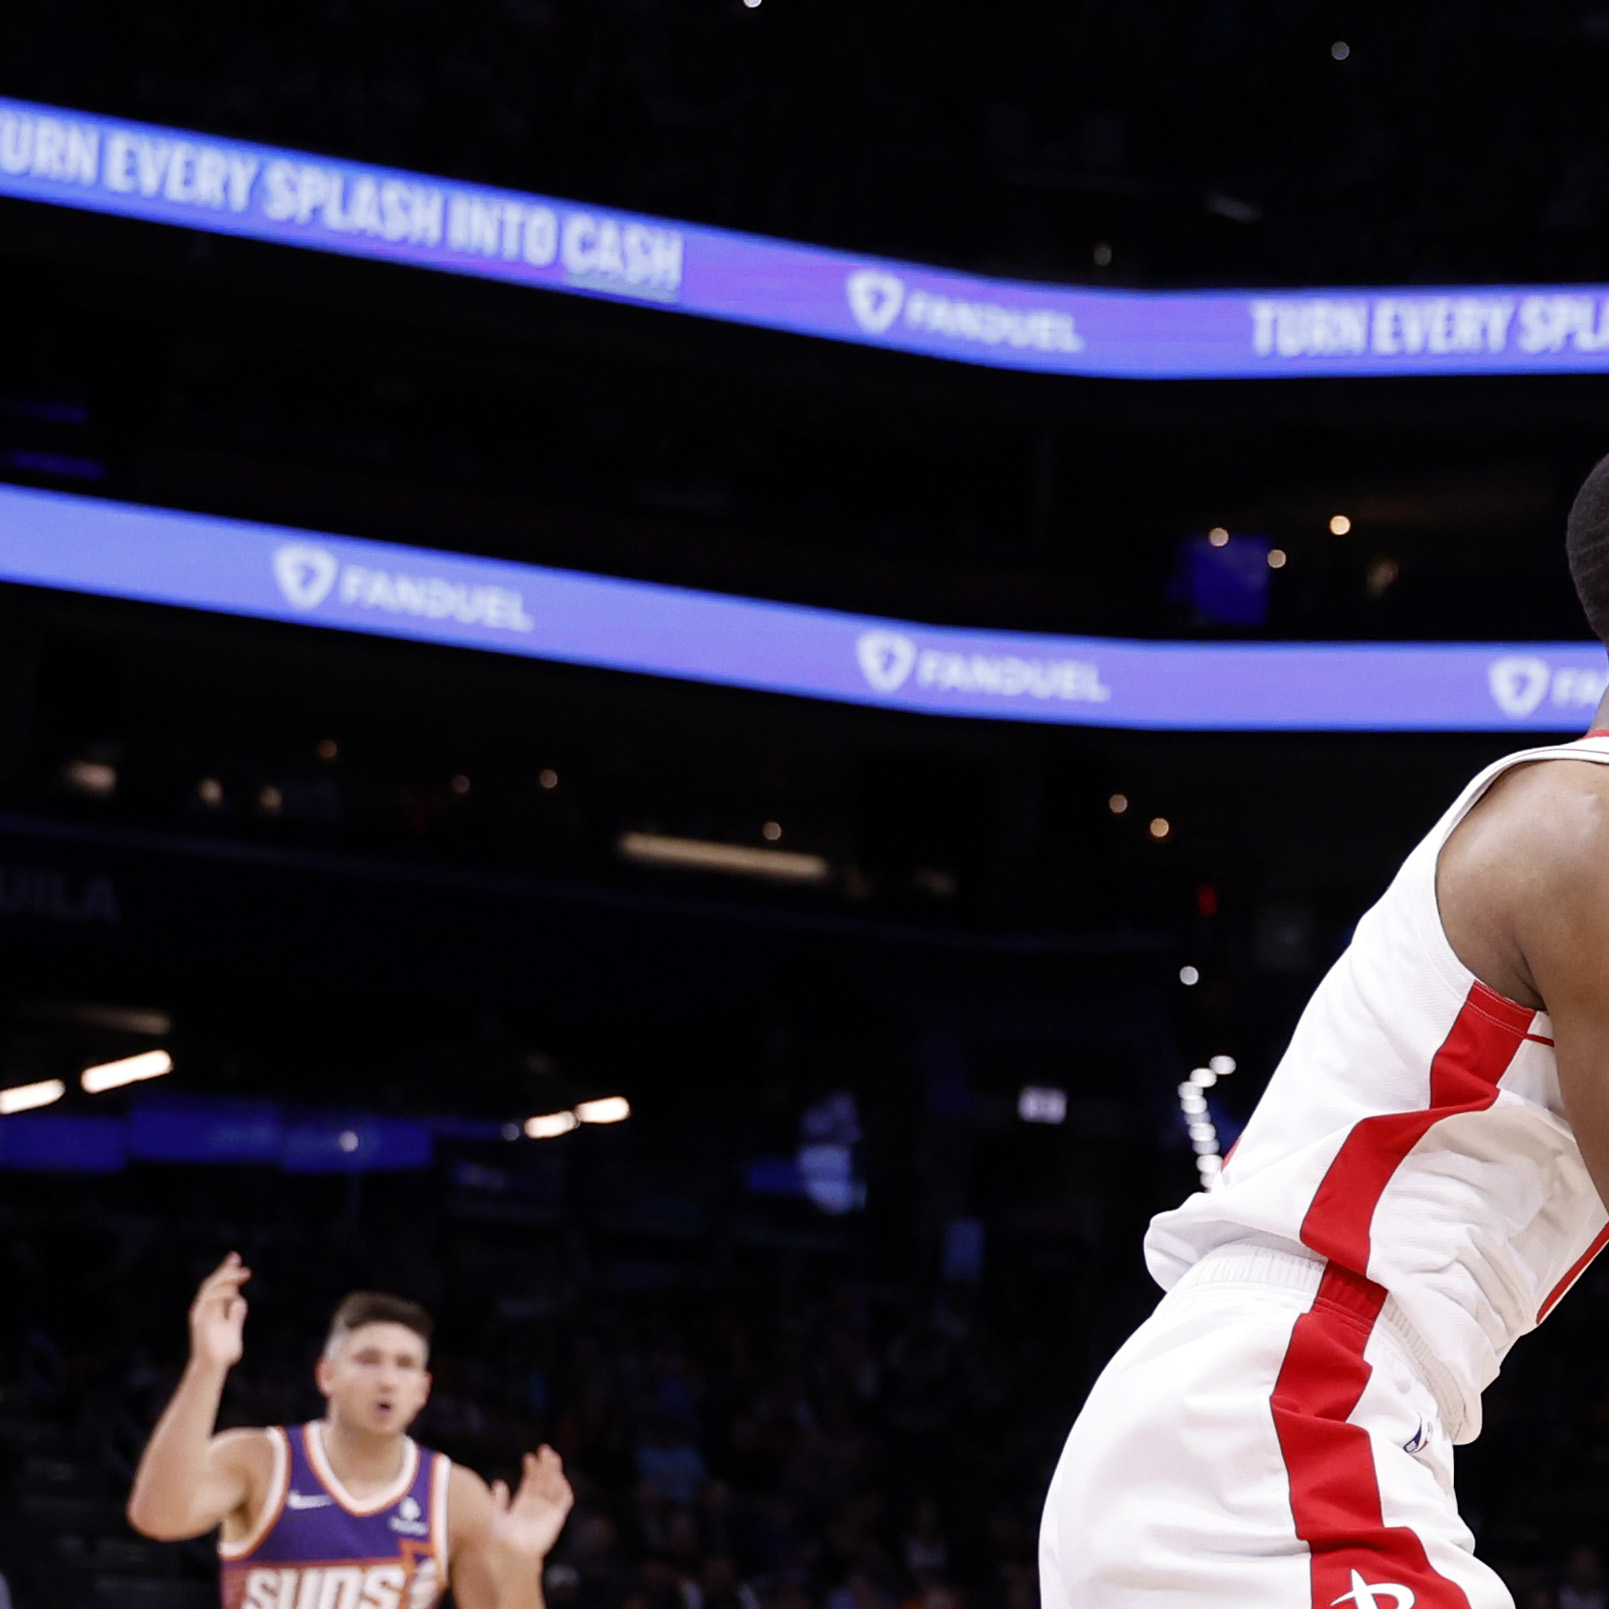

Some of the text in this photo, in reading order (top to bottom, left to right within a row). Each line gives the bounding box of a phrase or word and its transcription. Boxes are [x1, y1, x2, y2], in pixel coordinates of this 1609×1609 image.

[0, 110, 683, 290] URN EVERY SPLASH INTO CASH
[1250, 299, 1368, 357] TURN
[1372, 298, 1513, 354] EVERY
[340, 564, 534, 632] FANDUEL
[917, 648, 1110, 702] FANDUEL
